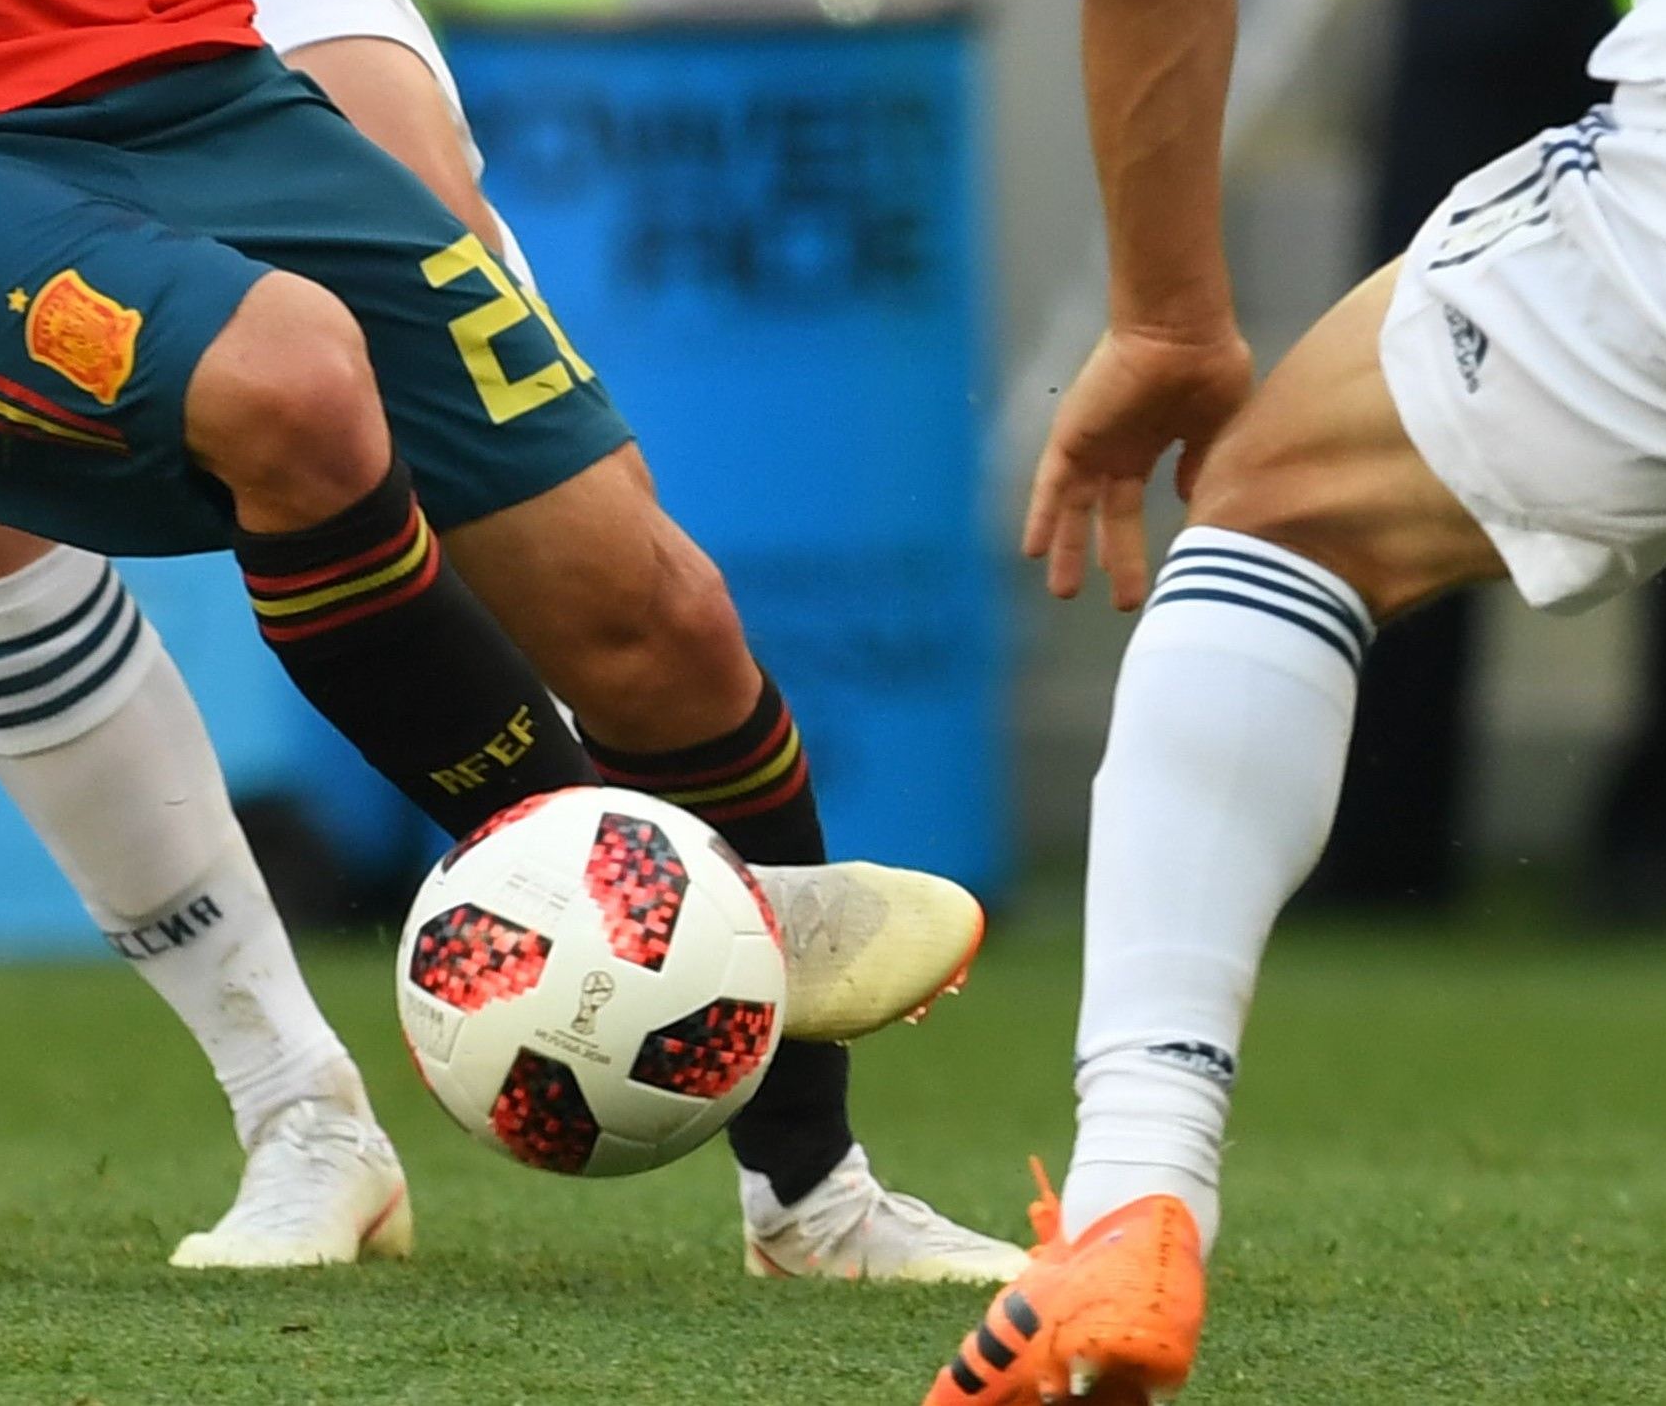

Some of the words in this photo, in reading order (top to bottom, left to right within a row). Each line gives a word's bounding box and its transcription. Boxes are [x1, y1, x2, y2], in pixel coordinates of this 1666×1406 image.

[420, 232, 595, 424] 2
[429, 703, 535, 795] RFEF
[102, 894, 223, 961] ССИЯ
